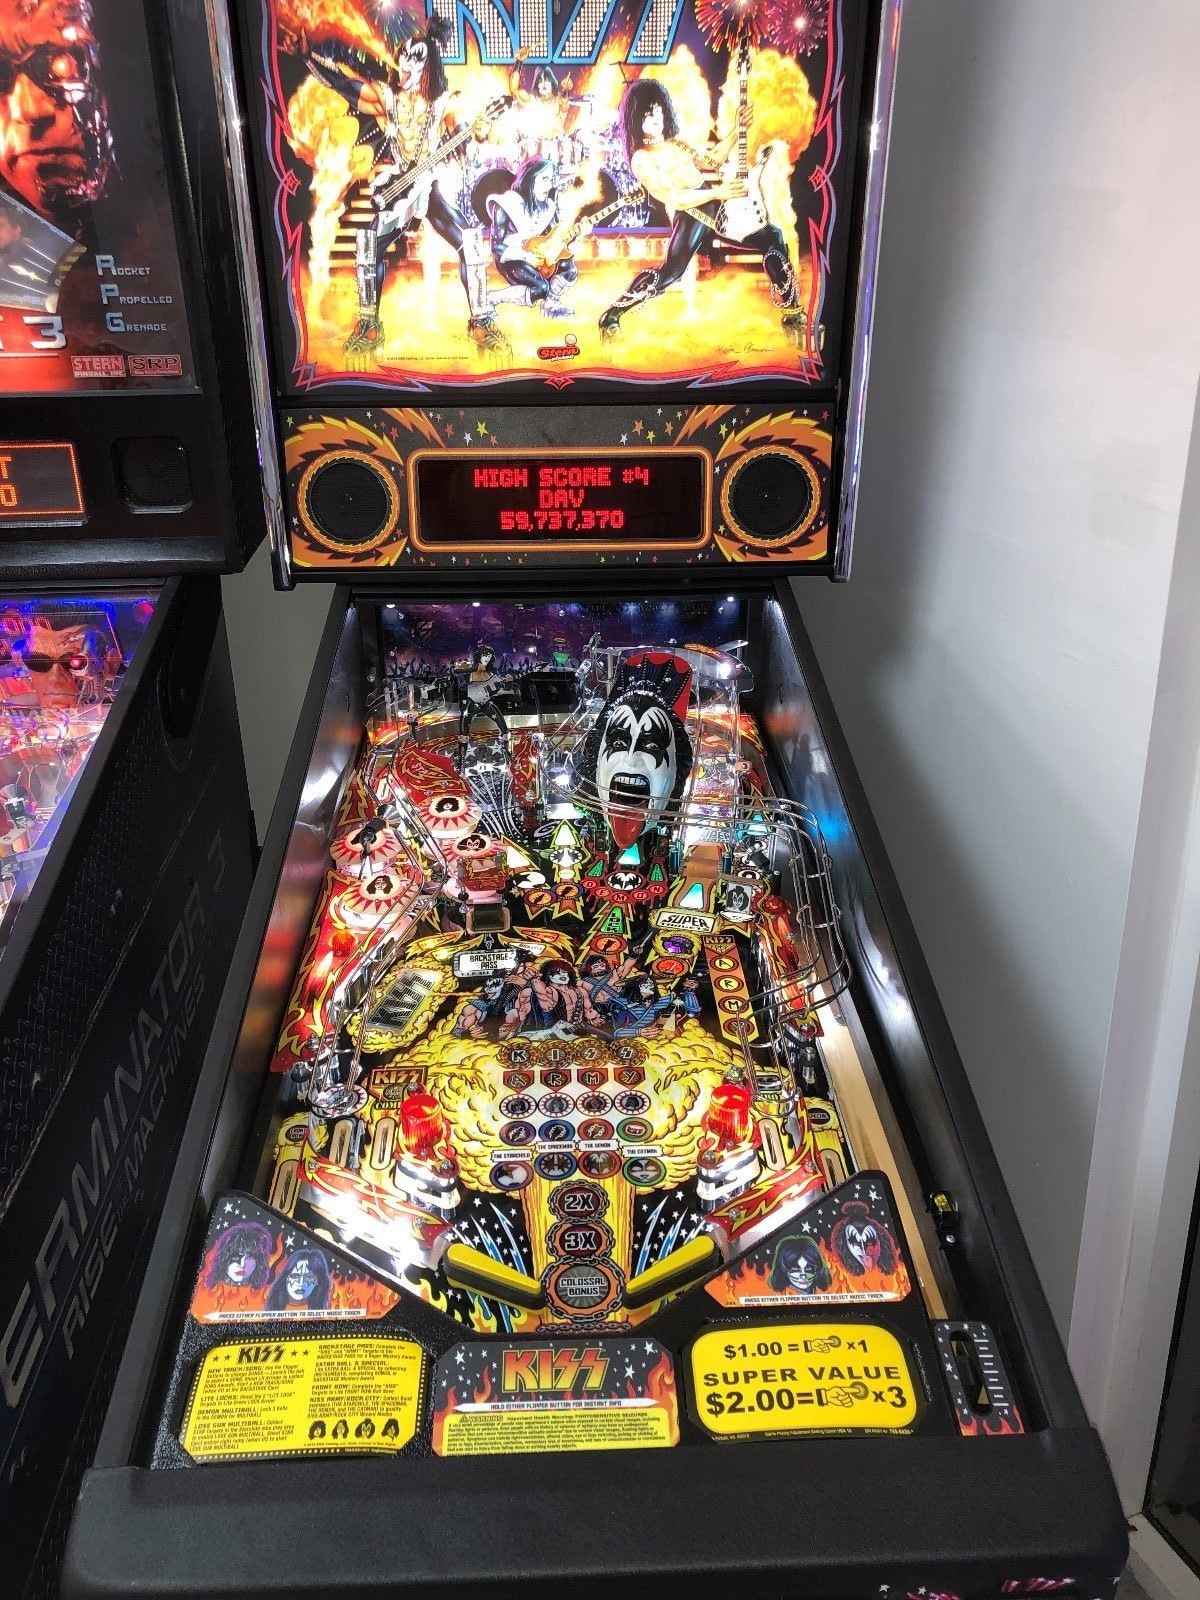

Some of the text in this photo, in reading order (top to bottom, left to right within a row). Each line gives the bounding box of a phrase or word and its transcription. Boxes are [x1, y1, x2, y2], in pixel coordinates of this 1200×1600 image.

[96, 255, 150, 276] ROCKET
[100, 284, 173, 304] PROPELLED
[106, 312, 167, 332] GRENADE
[74, 358, 178, 371] STERN SRP
[474, 468, 528, 488] HIGH
[539, 467, 612, 487] SCORE
[622, 466, 649, 486] #4
[500, 510, 624, 532] 59,737,370
[661, 914, 710, 929] SUPER
[470, 954, 509, 963] BACKSTAGE
[481, 962, 498, 970] PASS
[375, 1070, 420, 1084] KISS
[565, 1194, 594, 1212] 2X
[565, 1232, 597, 1251] 3X
[560, 1278, 606, 1287] COLOSSAL
[568, 1288, 600, 1296] BONUS
[237, 1346, 287, 1364] KISS
[724, 1341, 783, 1360] $1.00
[846, 1339, 868, 1354] x1
[502, 1348, 610, 1394] KISS
[704, 1366, 901, 1387] SUPER VALUE
[584, 1400, 608, 1408] INSTANT
[872, 1386, 907, 1409] x3
